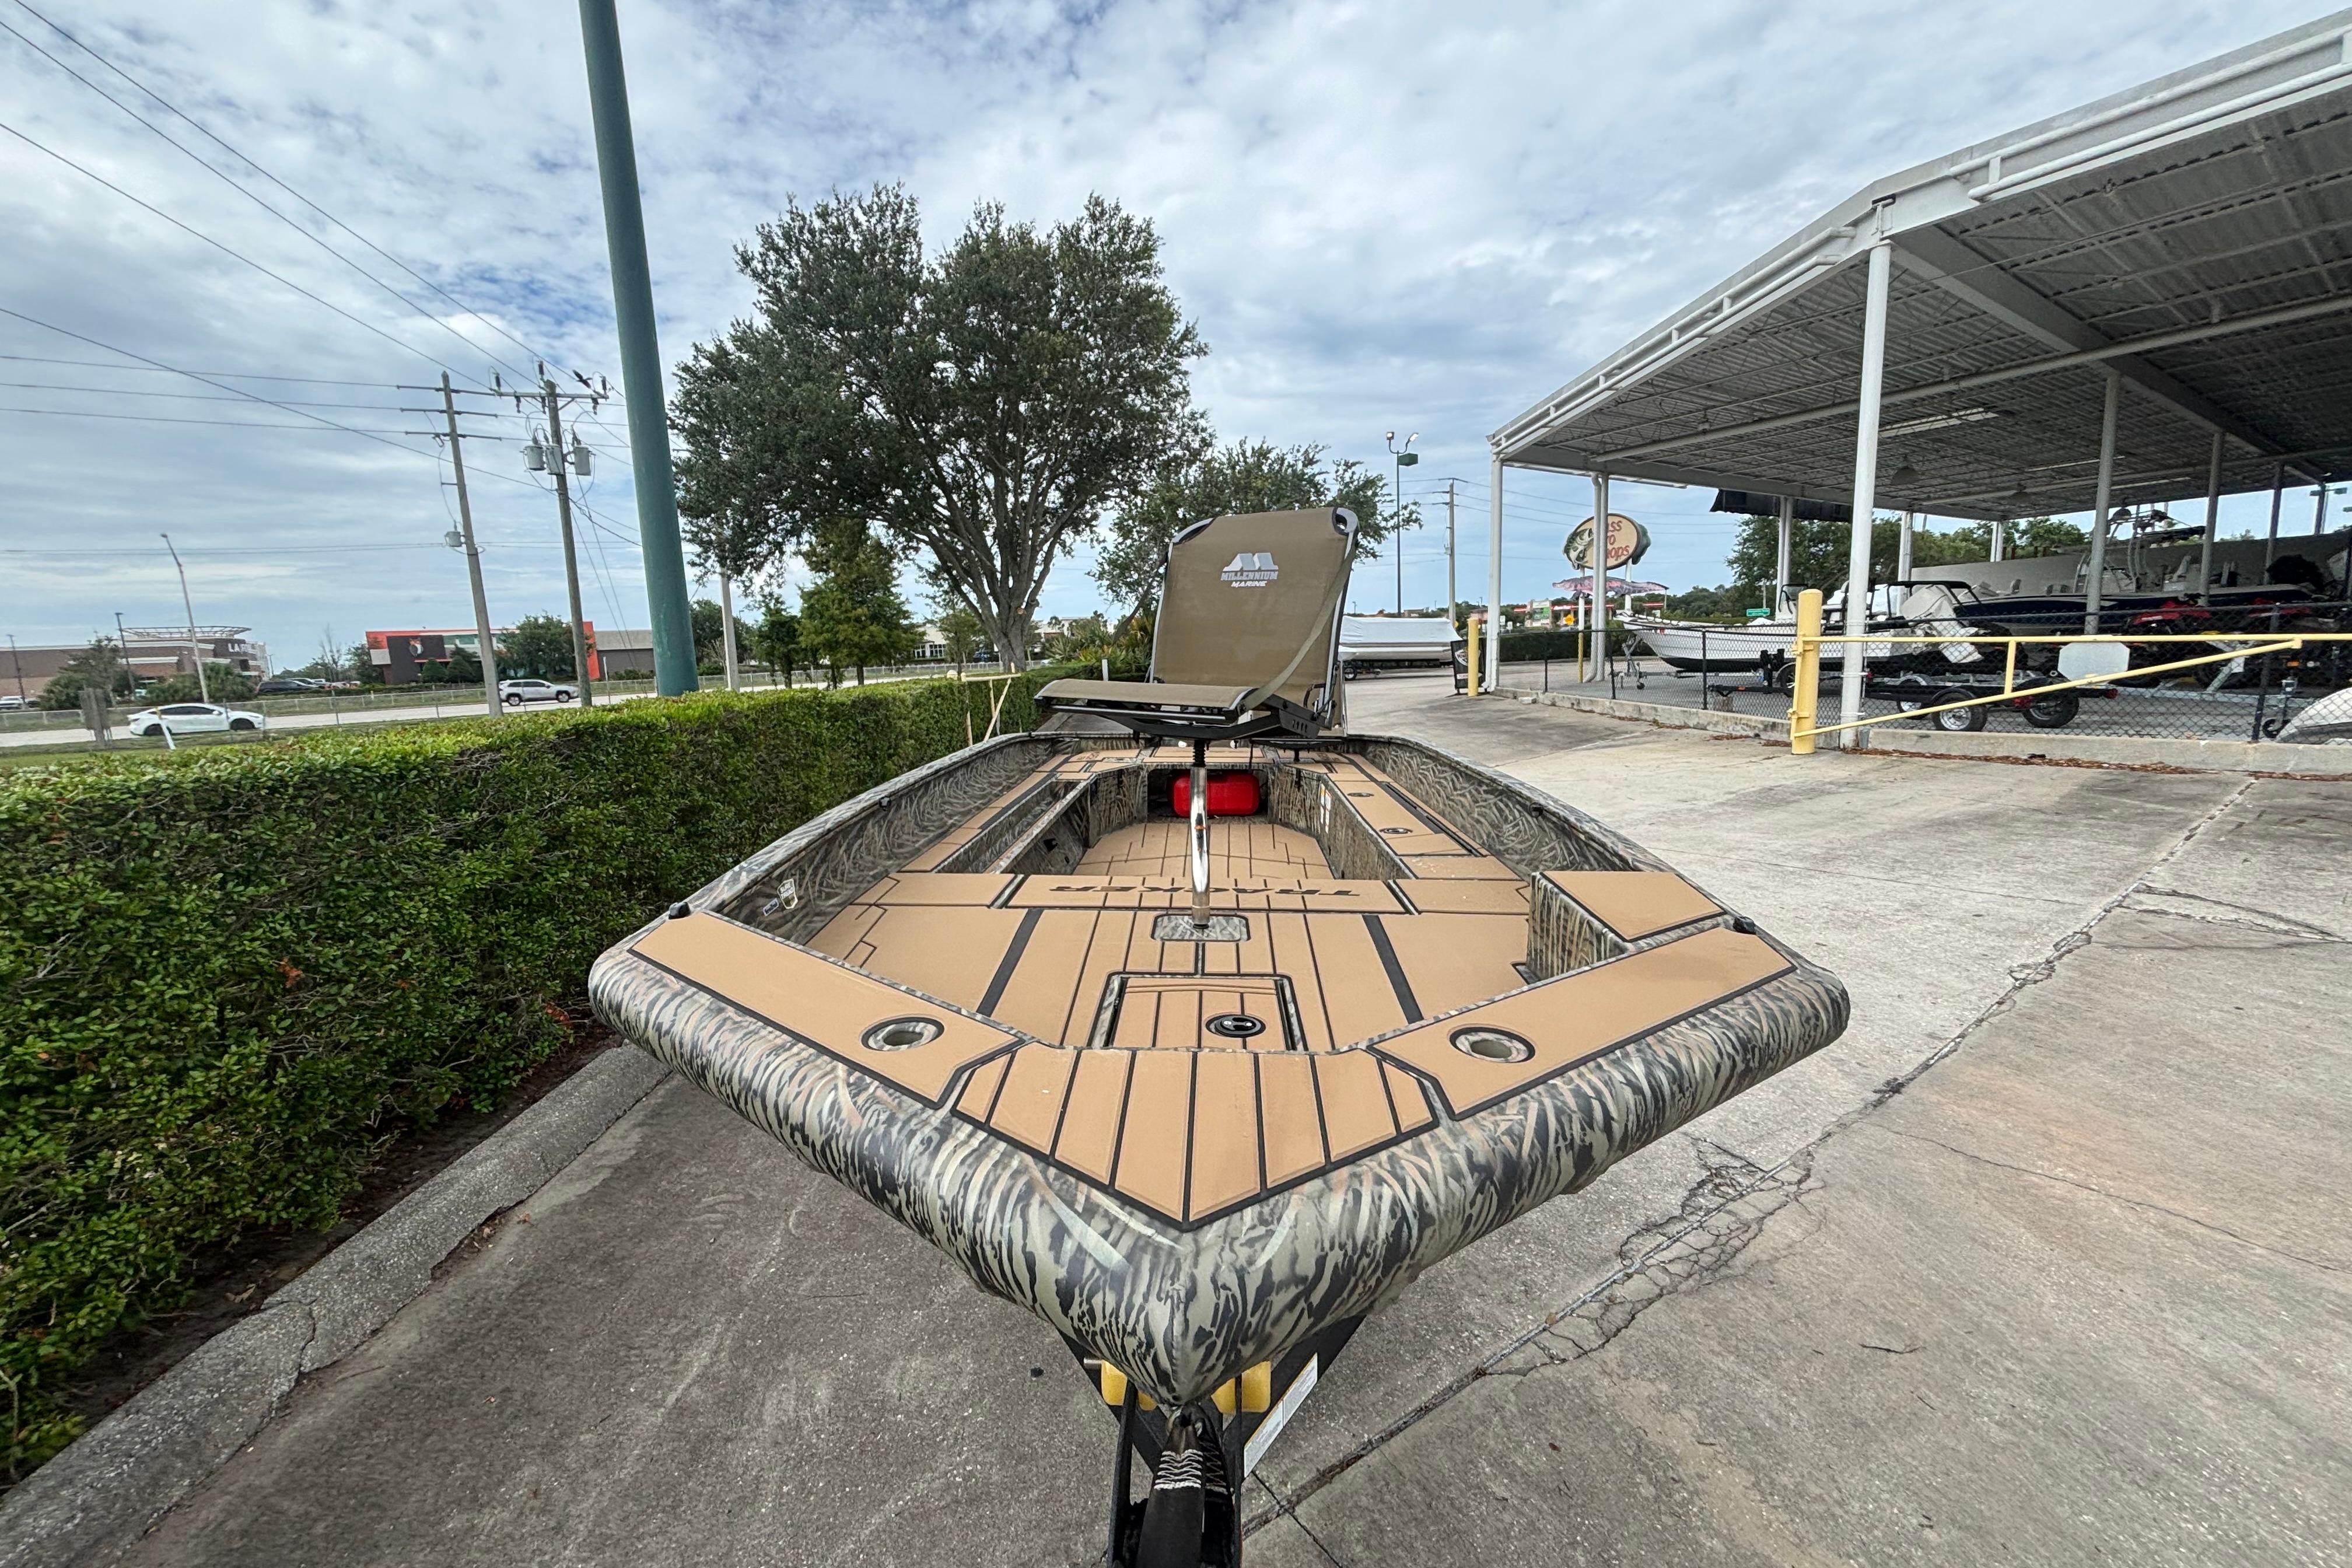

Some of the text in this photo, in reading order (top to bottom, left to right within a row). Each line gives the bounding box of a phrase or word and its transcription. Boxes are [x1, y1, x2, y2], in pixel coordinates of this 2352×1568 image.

[1607, 520, 1622, 533] ss
[1607, 545, 1629, 561] ops
[1220, 571, 1278, 581] MILLENNIUM
[228, 643, 240, 652] LA
[1049, 886, 1360, 897] TRACKER
